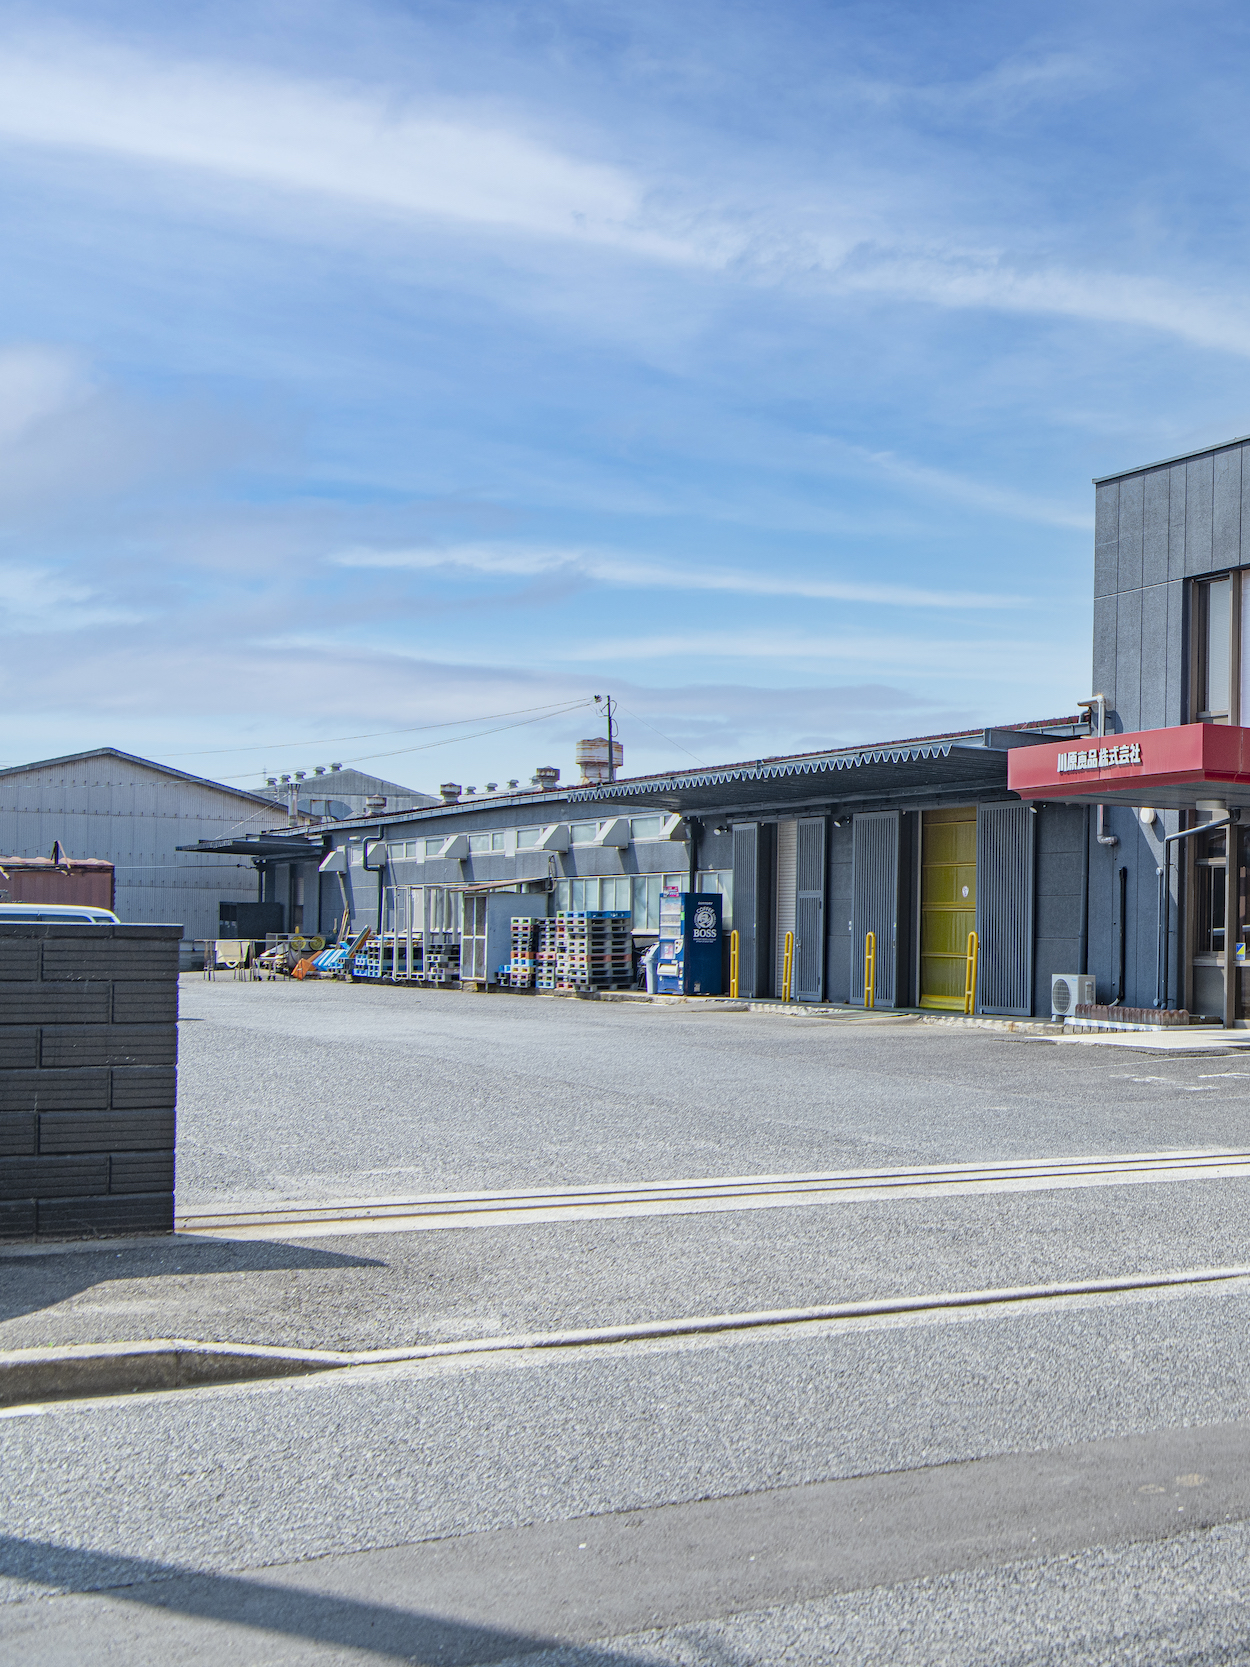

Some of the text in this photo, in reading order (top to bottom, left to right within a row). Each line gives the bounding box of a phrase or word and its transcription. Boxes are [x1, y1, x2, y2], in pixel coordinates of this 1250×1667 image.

[1057, 743, 1141, 772] 川原食品株式会社
[693, 929, 717, 938] BOSS
